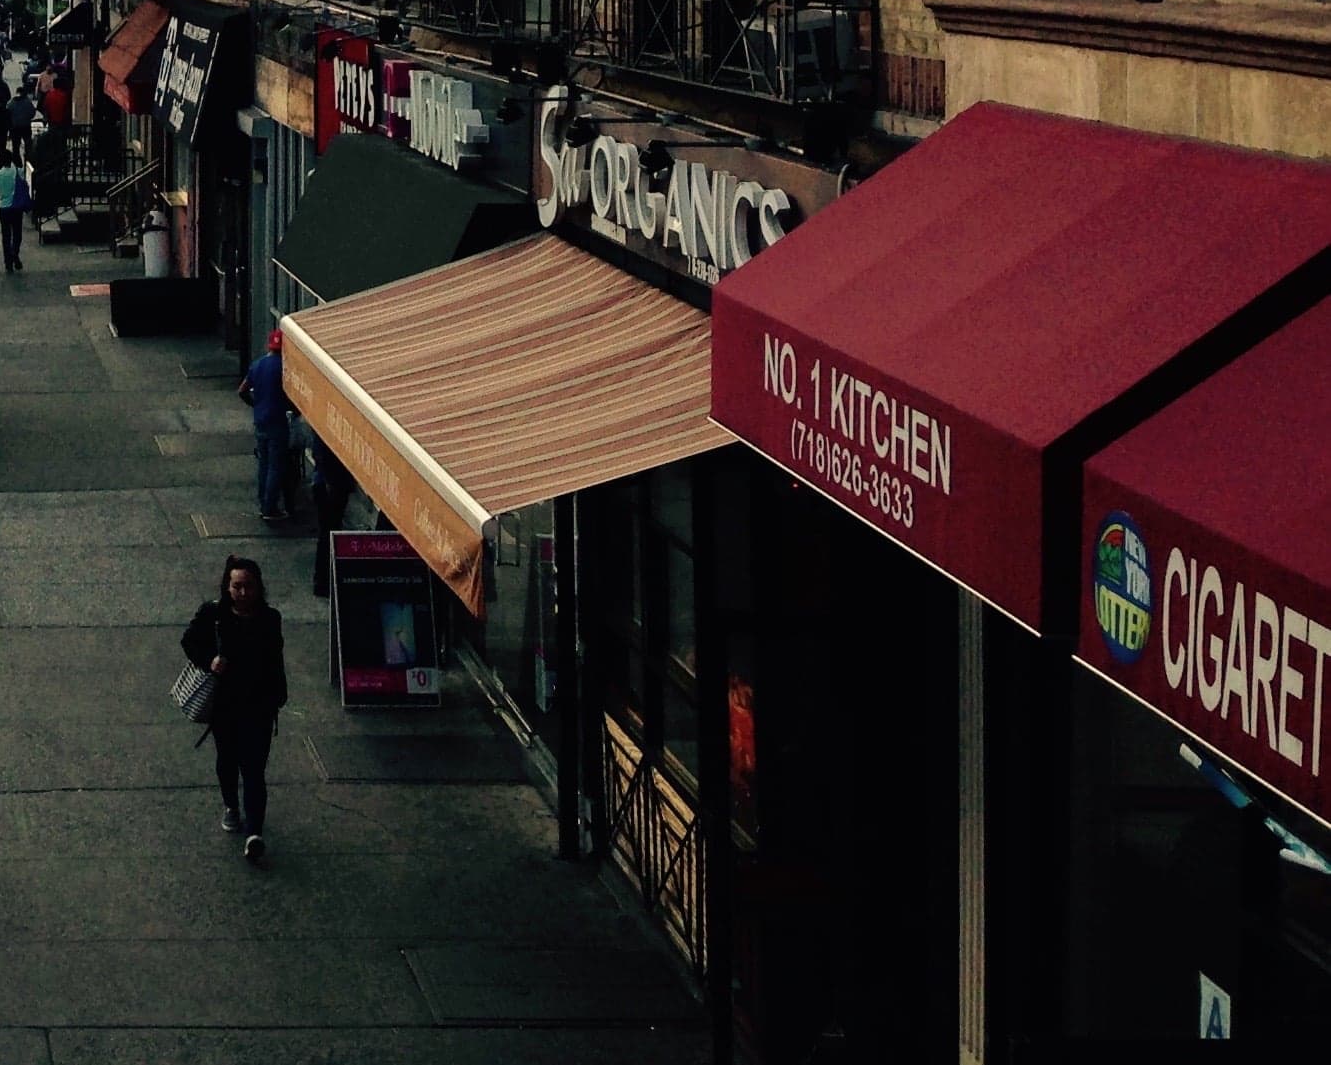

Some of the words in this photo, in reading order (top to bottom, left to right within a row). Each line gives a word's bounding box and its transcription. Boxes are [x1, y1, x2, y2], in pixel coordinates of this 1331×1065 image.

[764, 332, 802, 411] NO.
[810, 358, 821, 421] 1
[830, 366, 951, 497] KITCHEN
[791, 417, 914, 529] (718)626-3633
[1124, 526, 1147, 569] NEW
[1124, 555, 1150, 608] YORK
[1162, 546, 1331, 777] CIGARET
